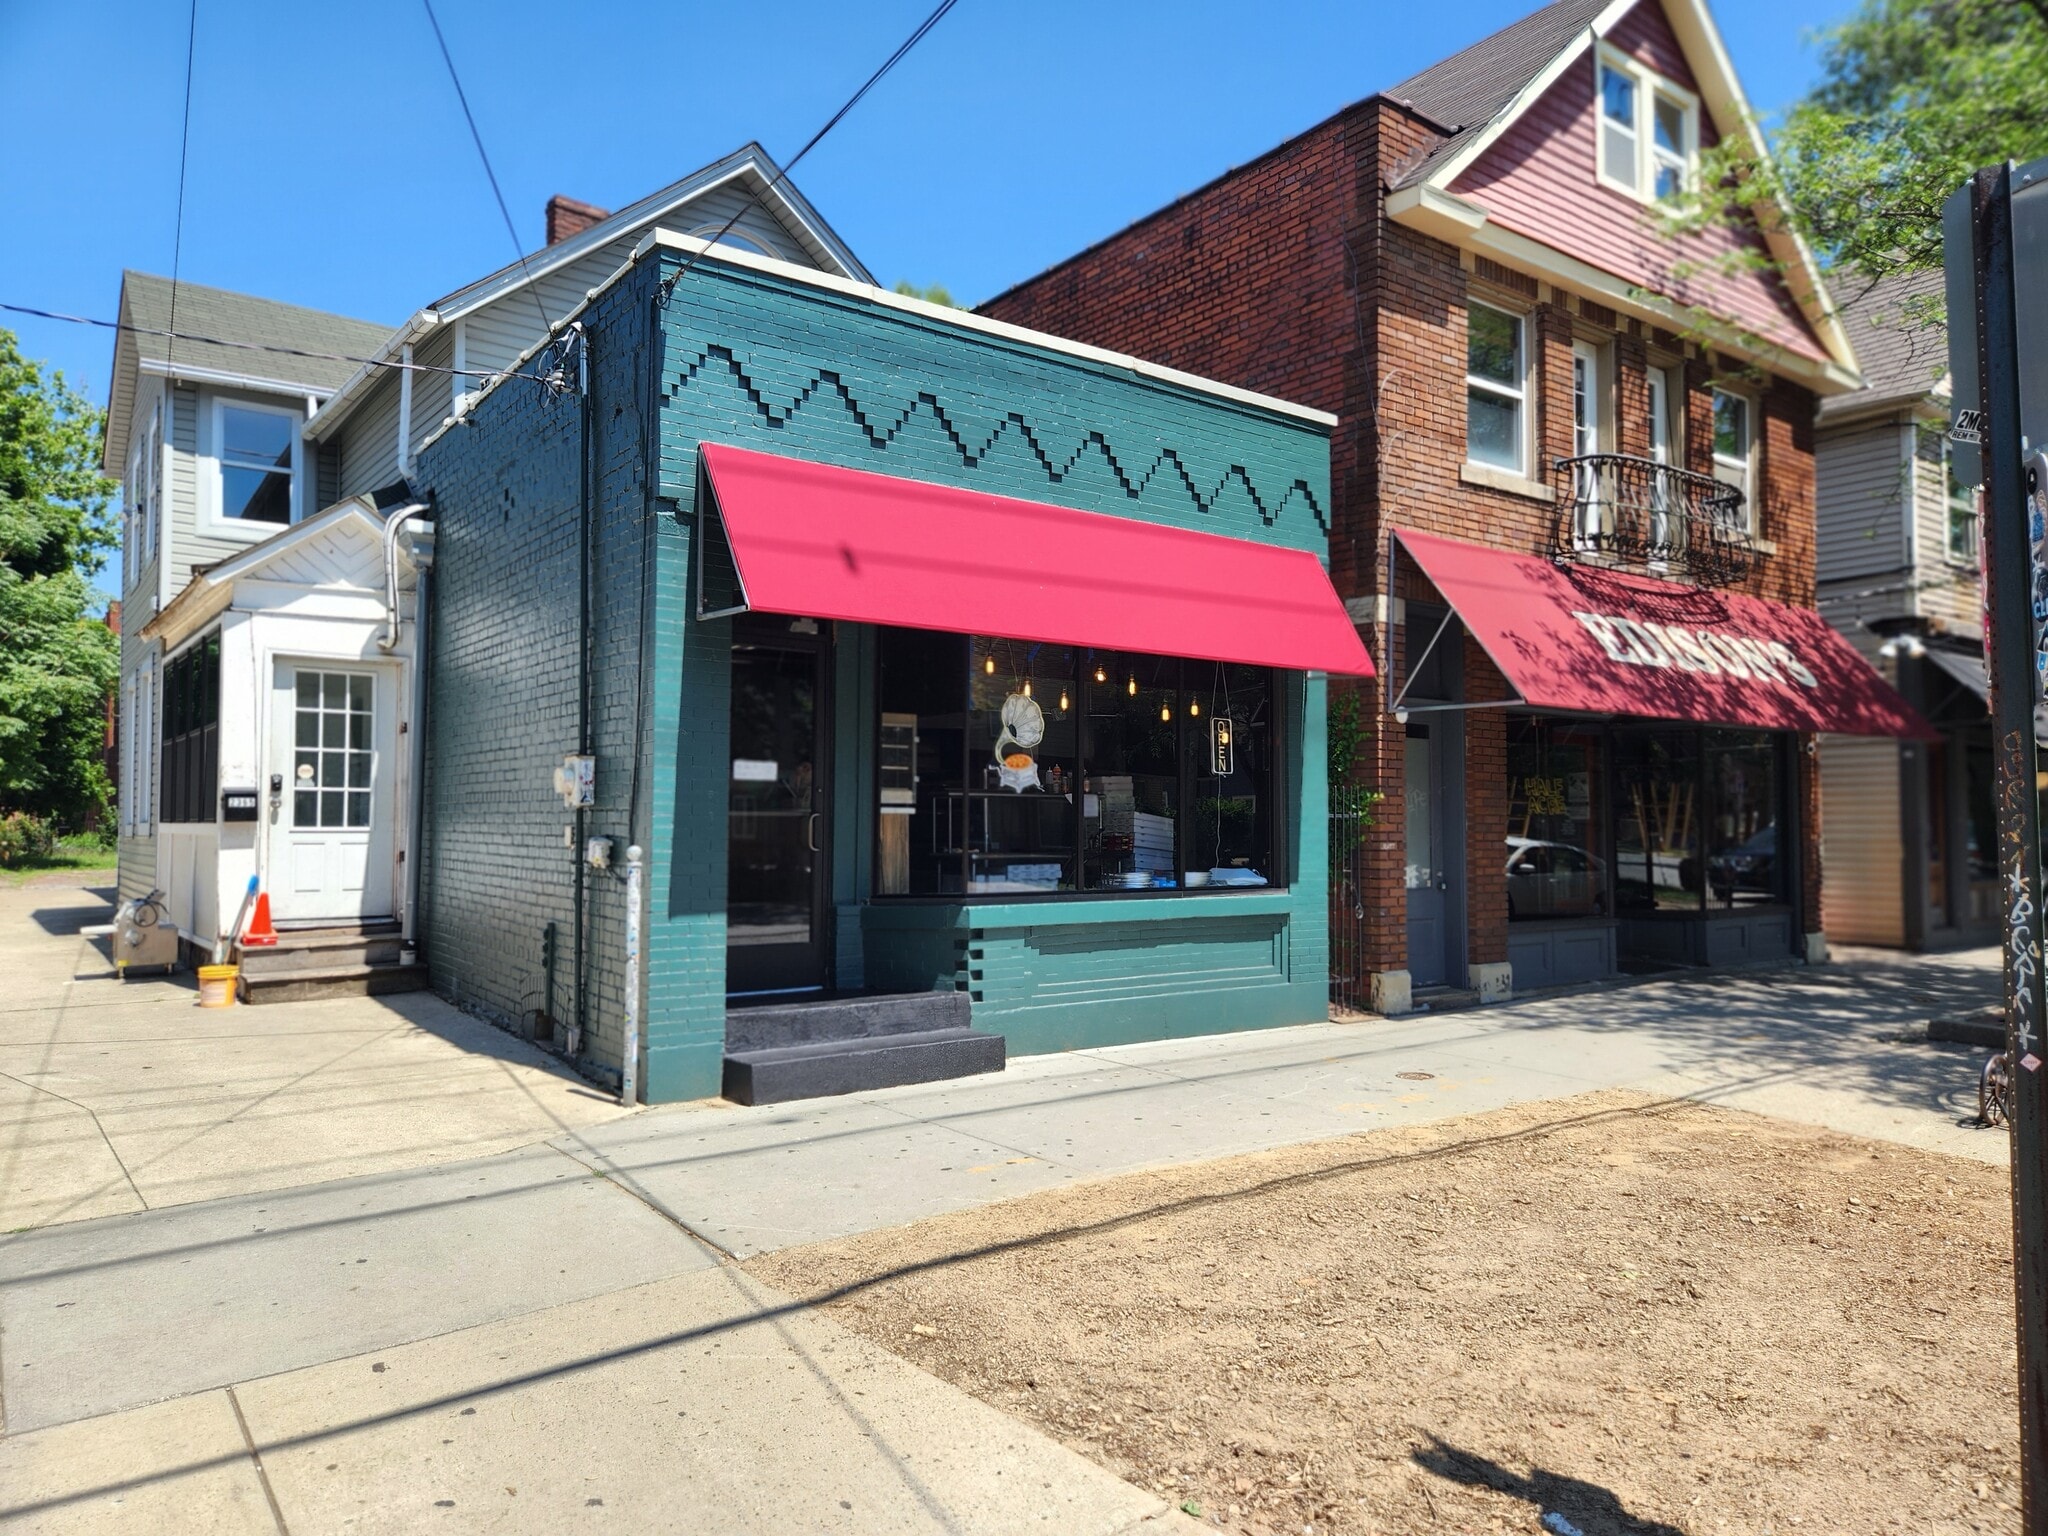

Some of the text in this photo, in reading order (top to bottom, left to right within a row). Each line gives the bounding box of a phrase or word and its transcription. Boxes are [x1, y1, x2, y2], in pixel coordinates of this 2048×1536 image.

[1571, 611, 1818, 687] EDISON'S
[1218, 721, 1227, 771] OPEN
[1524, 777, 1564, 797] HALF
[1528, 796, 1567, 816] ACRE
